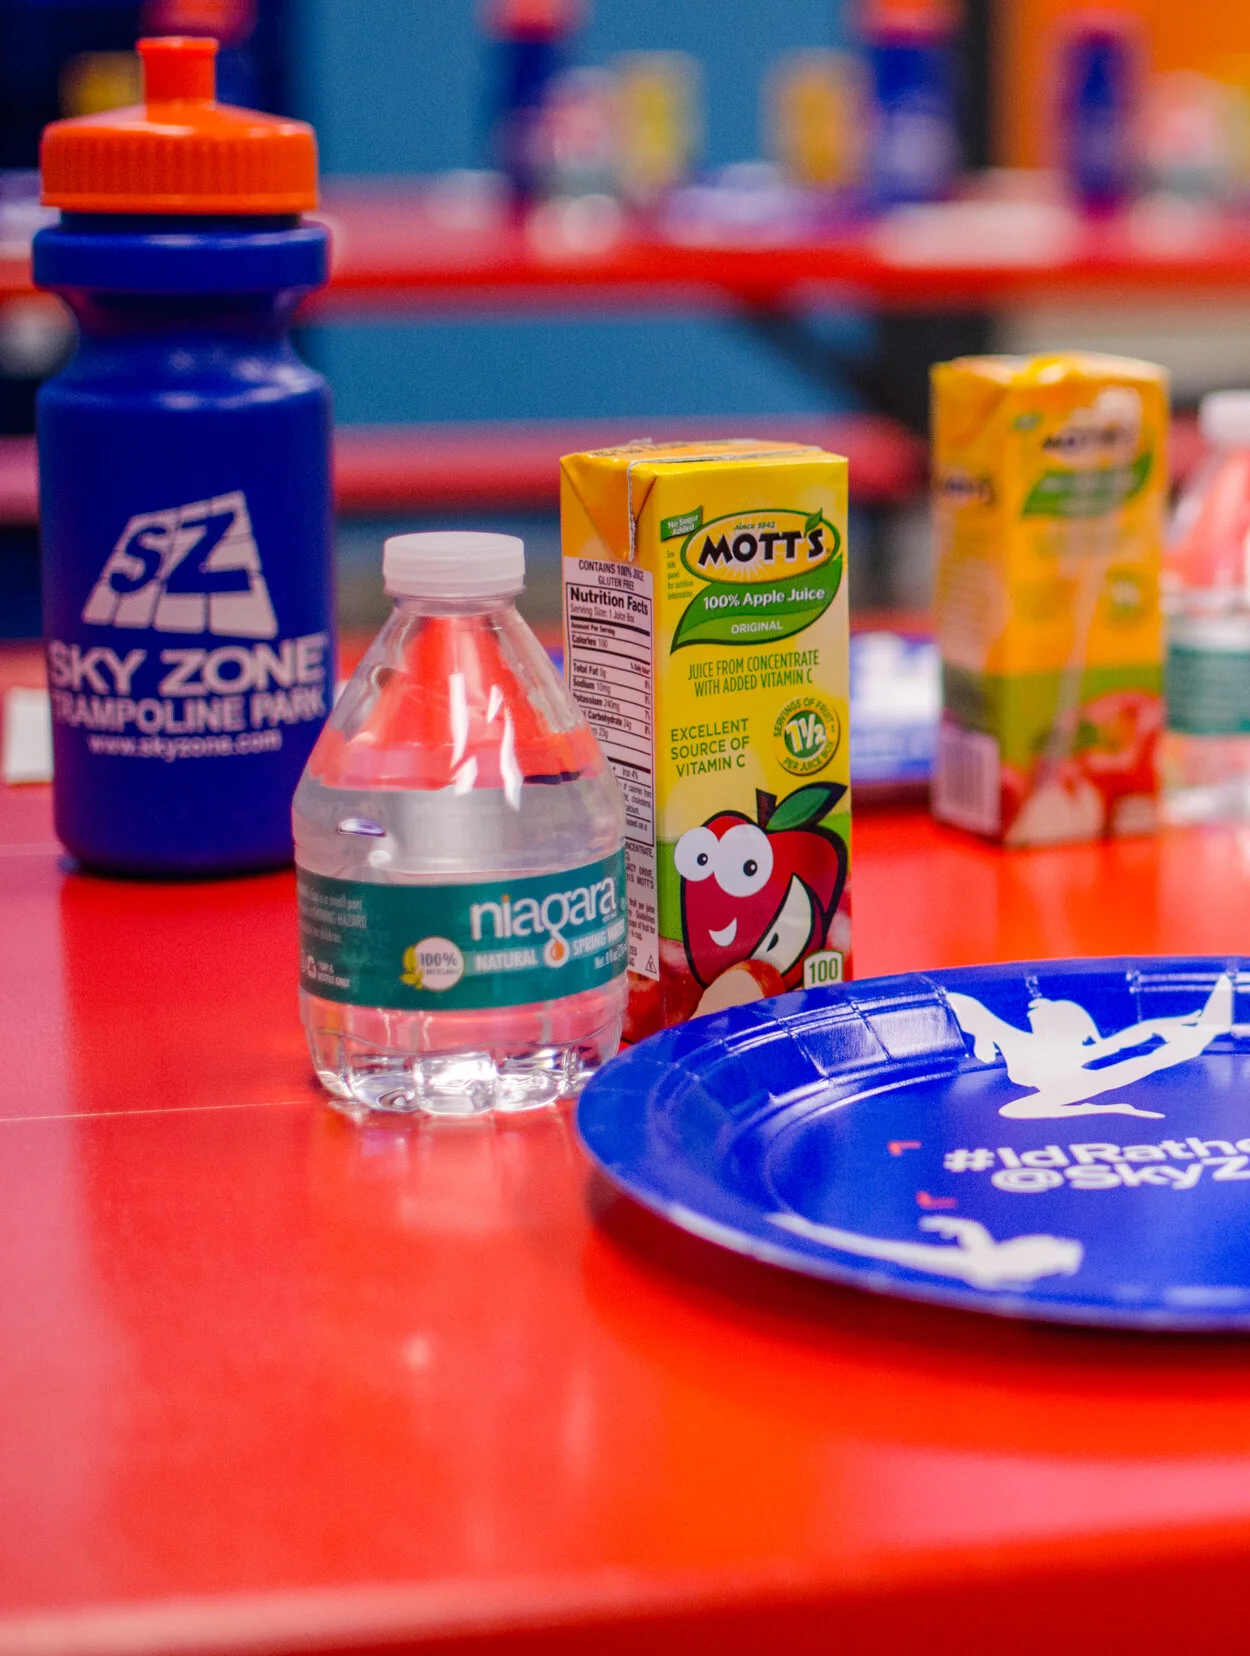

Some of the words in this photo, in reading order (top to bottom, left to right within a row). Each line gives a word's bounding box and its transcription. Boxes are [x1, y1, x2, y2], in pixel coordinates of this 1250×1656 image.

[698, 529, 825, 567] MOTT'S
[578, 559, 616, 575] CONTAINS
[617, 564, 632, 578] 100%
[633, 568, 645, 582] JUICE
[598, 575, 622, 588] GLUTEN
[623, 579, 635, 591] FREE
[570, 586, 625, 609] Nutrition
[627, 595, 648, 616] Facts
[570, 603, 593, 617] Serving
[703, 593, 740, 611] 100%
[743, 591, 785, 609] Apple
[788, 588, 826, 603] Juice
[571, 622, 589, 631] Amount
[590, 624, 599, 632] Per
[599, 626, 616, 637] Serving
[571, 634, 597, 646] Calories
[731, 620, 783, 635] ORIGINAL
[50, 639, 147, 697] SKY
[159, 631, 328, 698] ZONE
[573, 662, 587, 674] Total
[588, 665, 599, 676] Fat
[688, 662, 713, 680] JUICE
[716, 657, 744, 676] FROM
[747, 649, 820, 673] CONCENTRATE
[573, 677, 595, 691] Sodium
[694, 679, 720, 697] WITH
[723, 674, 757, 693] ADDED
[761, 670, 804, 689] VITAMIN
[806, 667, 813, 684] C
[50, 689, 245, 735] TRAMPOLINE
[252, 685, 325, 729] PARK
[773, 699, 802, 737] SERVINGS
[803, 697, 815, 707] OF
[815, 700, 834, 723] FRUIT
[671, 718, 749, 743] EXCELLENT
[87, 728, 283, 763] www.skyzone.com
[671, 740, 726, 760] SOURCE
[730, 735, 750, 751] OF
[676, 756, 732, 777] VITAMIN
[736, 754, 746, 768] C
[783, 757, 799, 769] PER
[799, 756, 822, 772] JUICE
[470, 876, 618, 941] niagara
[419, 951, 459, 968] 100%
[475, 947, 540, 974] NATURAL
[572, 930, 607, 957] SPRING
[809, 957, 839, 985] 100
